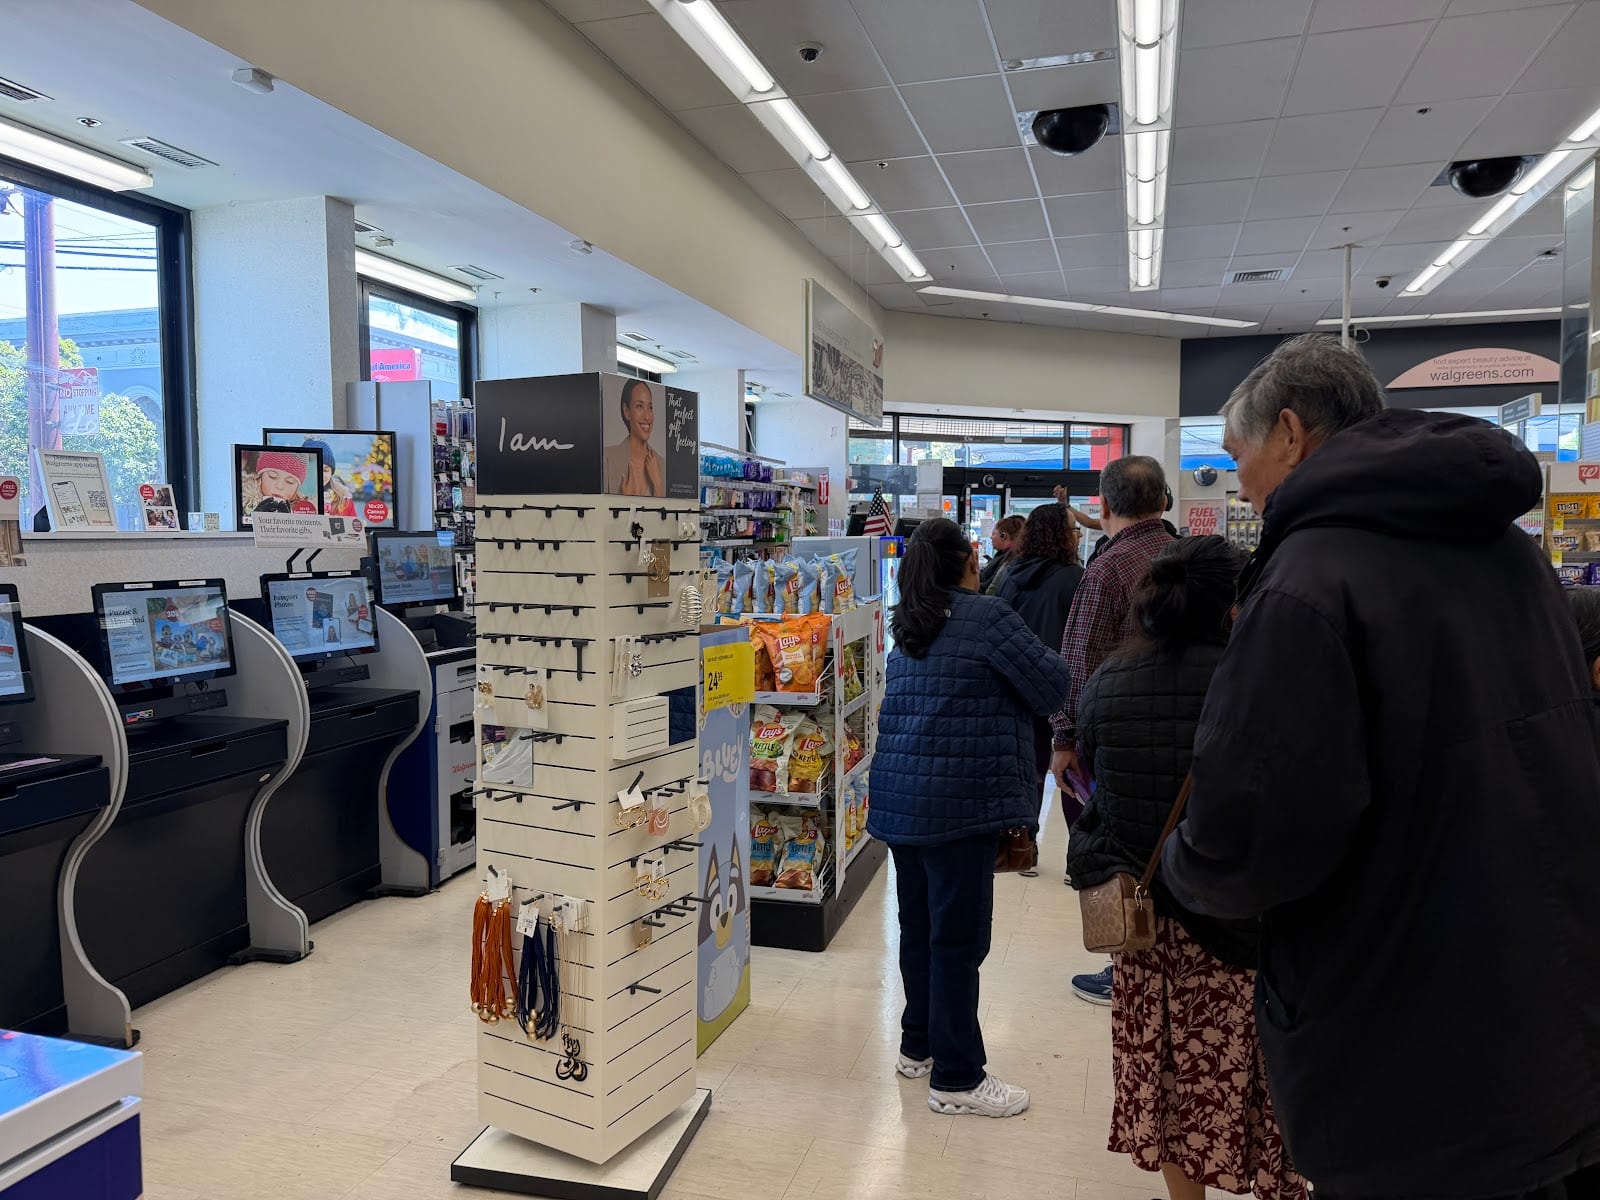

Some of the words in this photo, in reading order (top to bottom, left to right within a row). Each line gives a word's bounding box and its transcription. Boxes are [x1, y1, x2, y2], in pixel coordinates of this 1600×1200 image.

[380, 362, 411, 371] America
[1448, 357, 1471, 365] expert
[1473, 356, 1498, 364] beauty
[1430, 368, 1534, 382] walgreens.com
[59, 389, 72, 399] NO
[73, 386, 97, 398] STOPPING
[668, 393, 682, 408] That
[674, 406, 694, 424] perfect
[668, 419, 682, 438] gift
[510, 432, 575, 452] am
[676, 435, 697, 455] feeling
[1189, 507, 1215, 517] FUEL
[258, 517, 273, 525] Your
[273, 517, 295, 526] favorite
[1188, 518, 1217, 528] YOUR
[259, 525, 274, 534] Their
[274, 526, 298, 534] favorite
[298, 527, 313, 535] gifts.
[1191, 528, 1214, 537] FUN
[708, 672, 718, 691] 24
[753, 742, 775, 752] KETTLE
[702, 733, 744, 783] BLUEY
